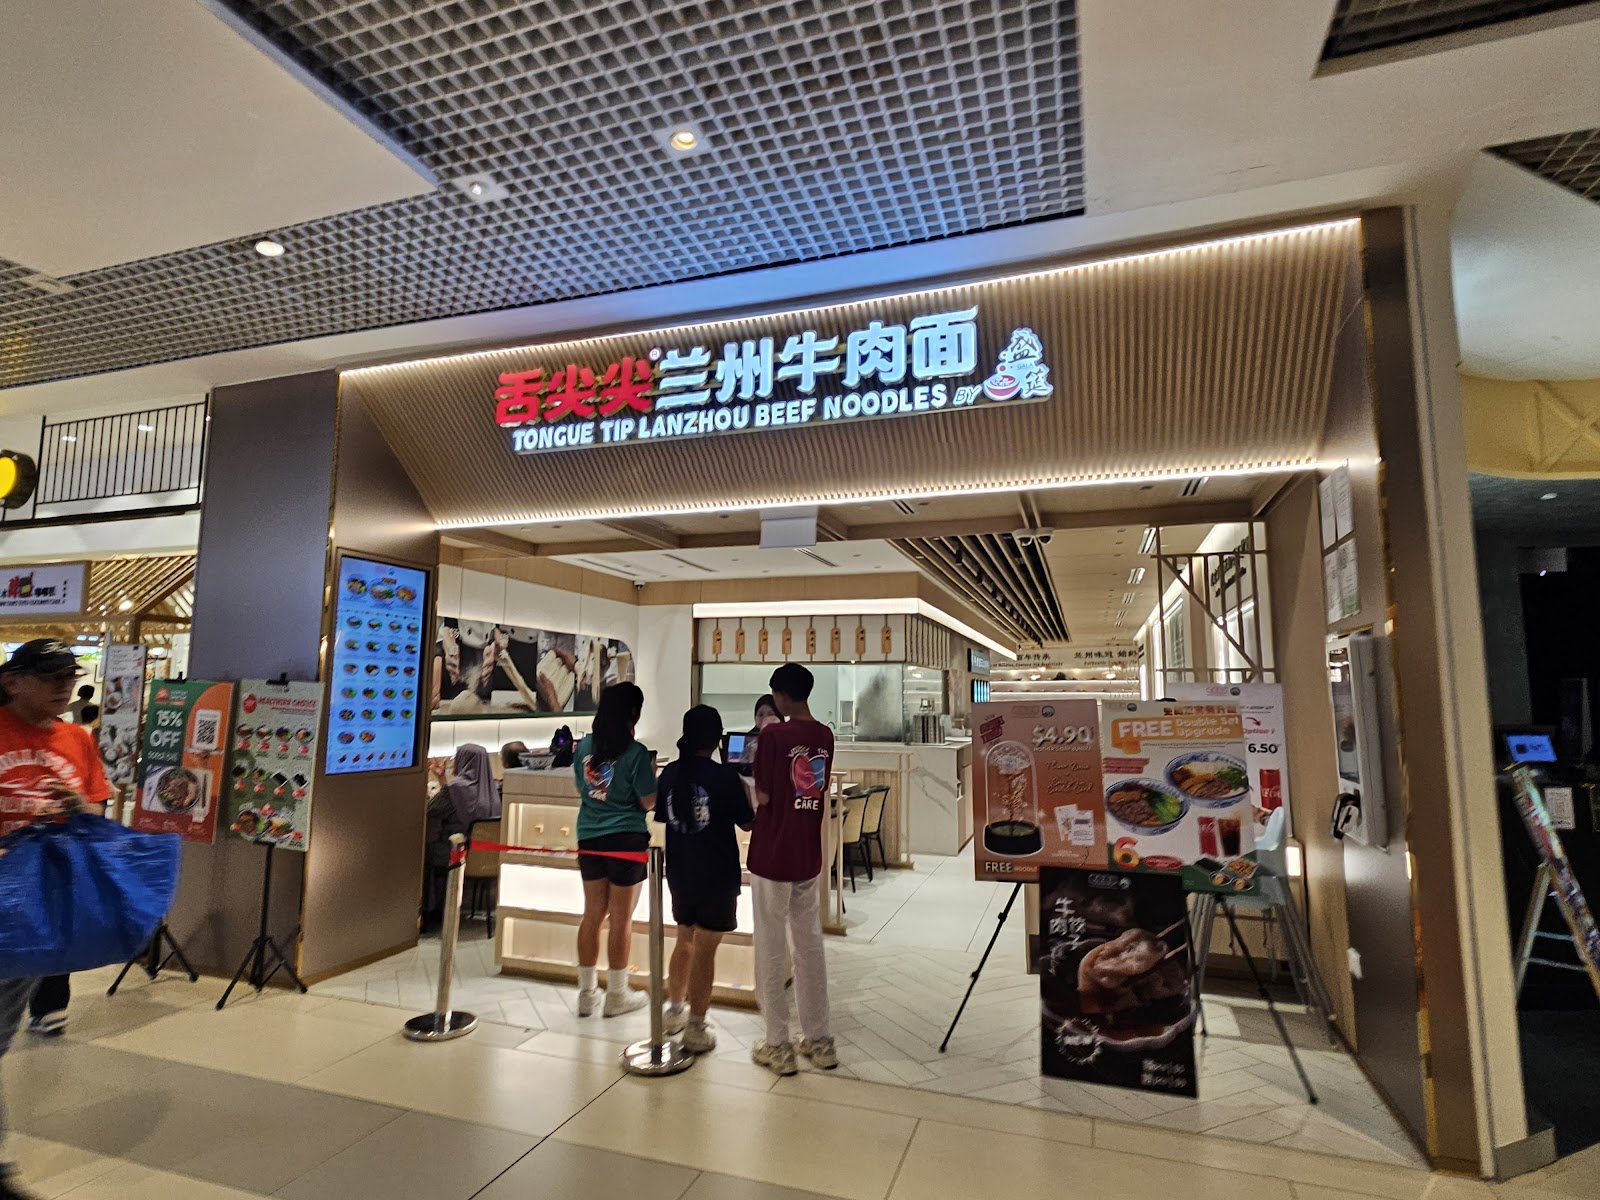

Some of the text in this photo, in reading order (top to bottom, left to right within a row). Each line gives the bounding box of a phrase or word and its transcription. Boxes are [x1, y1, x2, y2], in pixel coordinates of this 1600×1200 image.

[655, 305, 979, 410] 兰州牛肉面
[512, 383, 982, 452] TONGUE TIP LANZHOU BEEF NOODLES BY
[156, 710, 182, 728] 15%
[1032, 724, 1092, 748] $4.90
[1118, 720, 1175, 738] FREE
[149, 729, 182, 748] OFF
[1248, 743, 1279, 754] 6.50
[794, 798, 819, 811] CARE
[985, 861, 1013, 873] FREE
